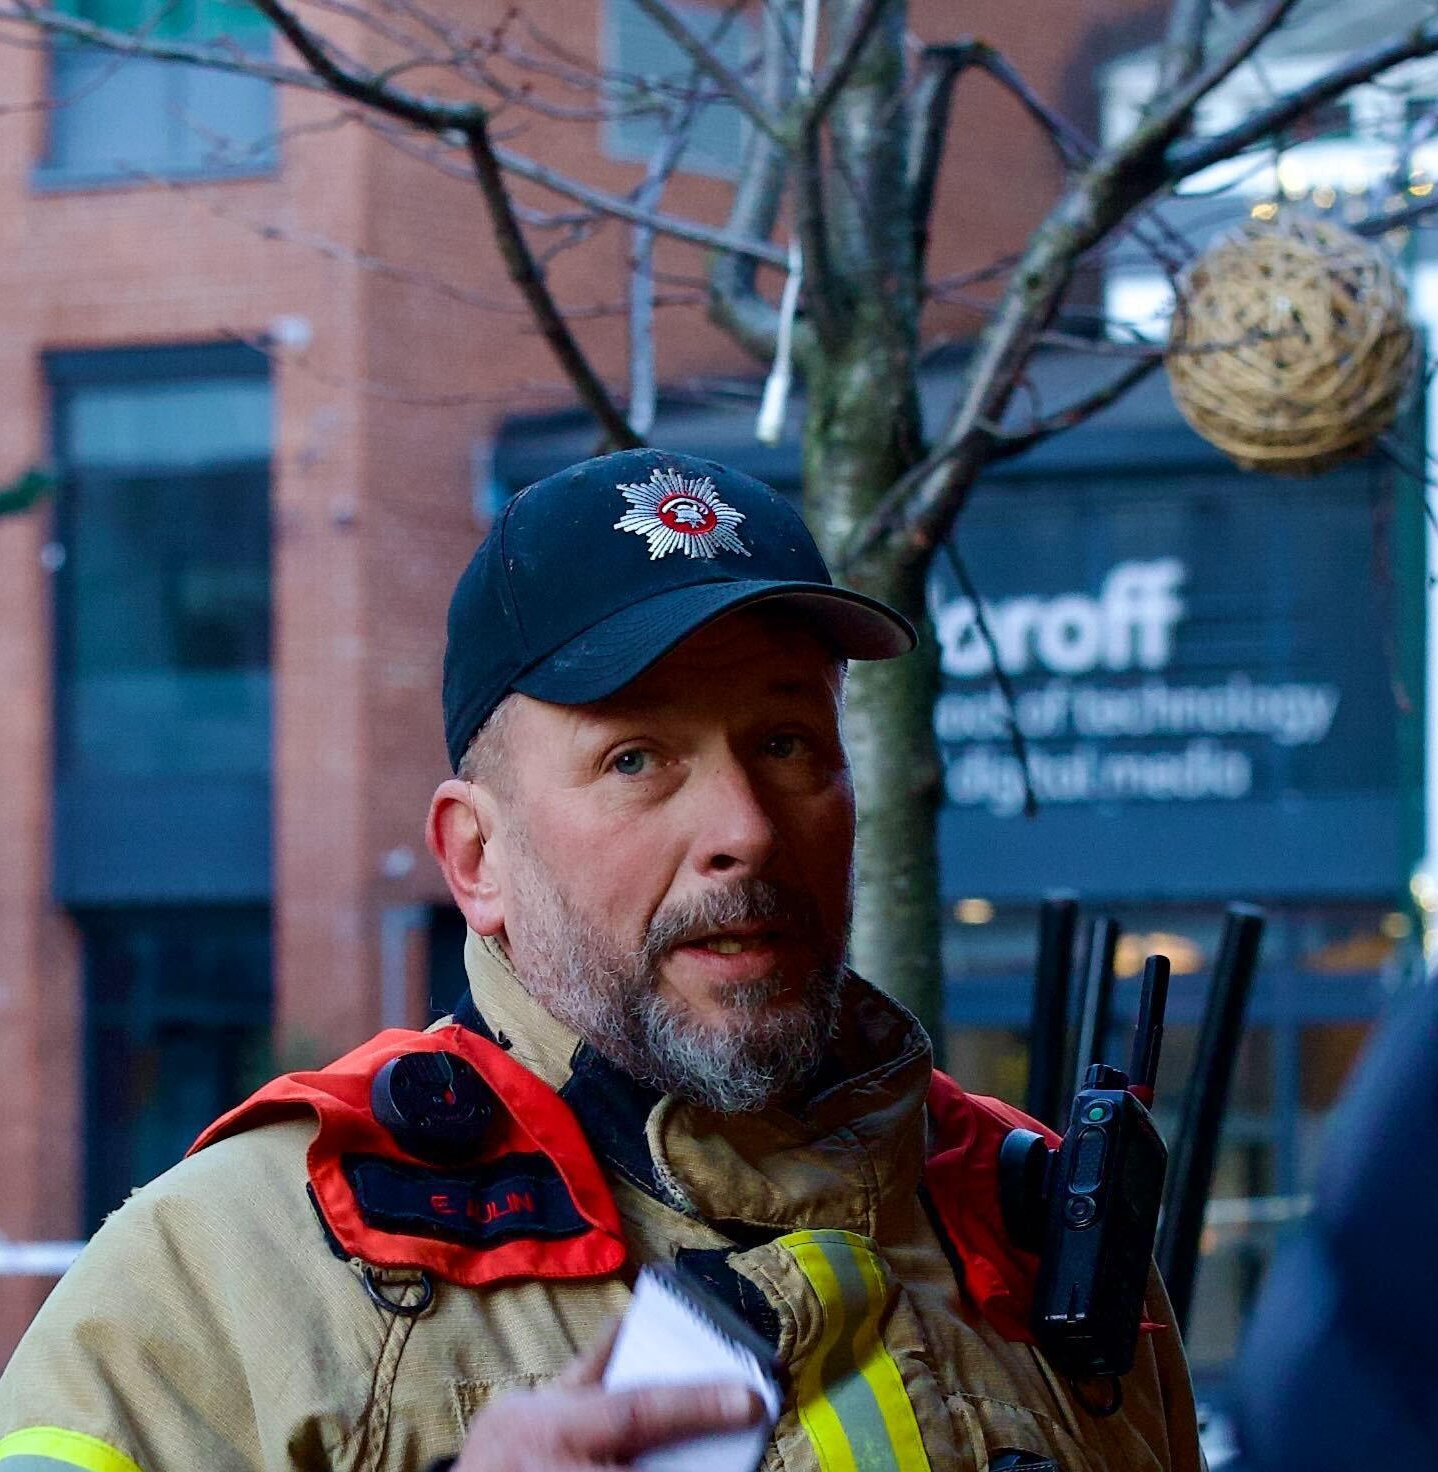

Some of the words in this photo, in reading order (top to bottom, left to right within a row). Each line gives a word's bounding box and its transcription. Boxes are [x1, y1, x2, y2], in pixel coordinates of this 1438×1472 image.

[929, 558, 1183, 677] oroff
[1016, 678, 1067, 736] of
[1071, 676, 1341, 745] technology
[1101, 740, 1251, 800] media
